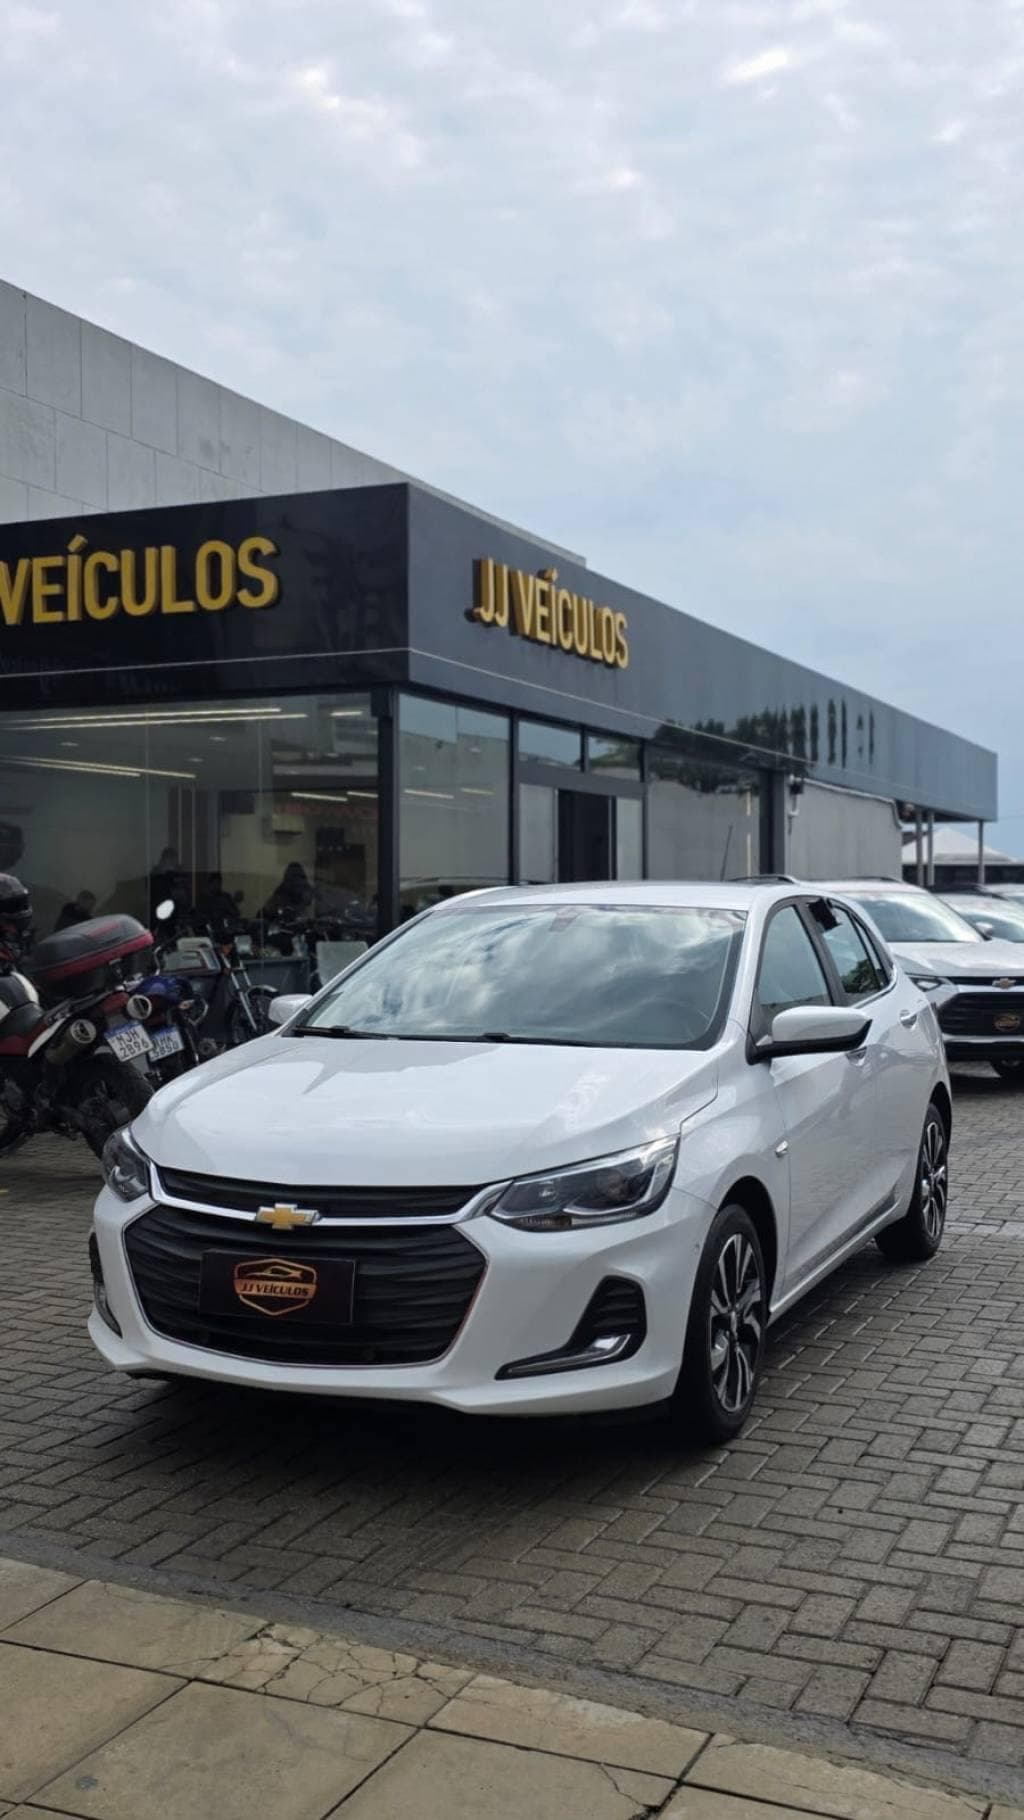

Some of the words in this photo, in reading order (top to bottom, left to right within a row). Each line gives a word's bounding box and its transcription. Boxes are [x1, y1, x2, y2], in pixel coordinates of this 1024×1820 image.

[0, 534, 279, 625] VEÍCULOS
[474, 557, 509, 627] JJ
[513, 568, 629, 669] VEÍCULOS
